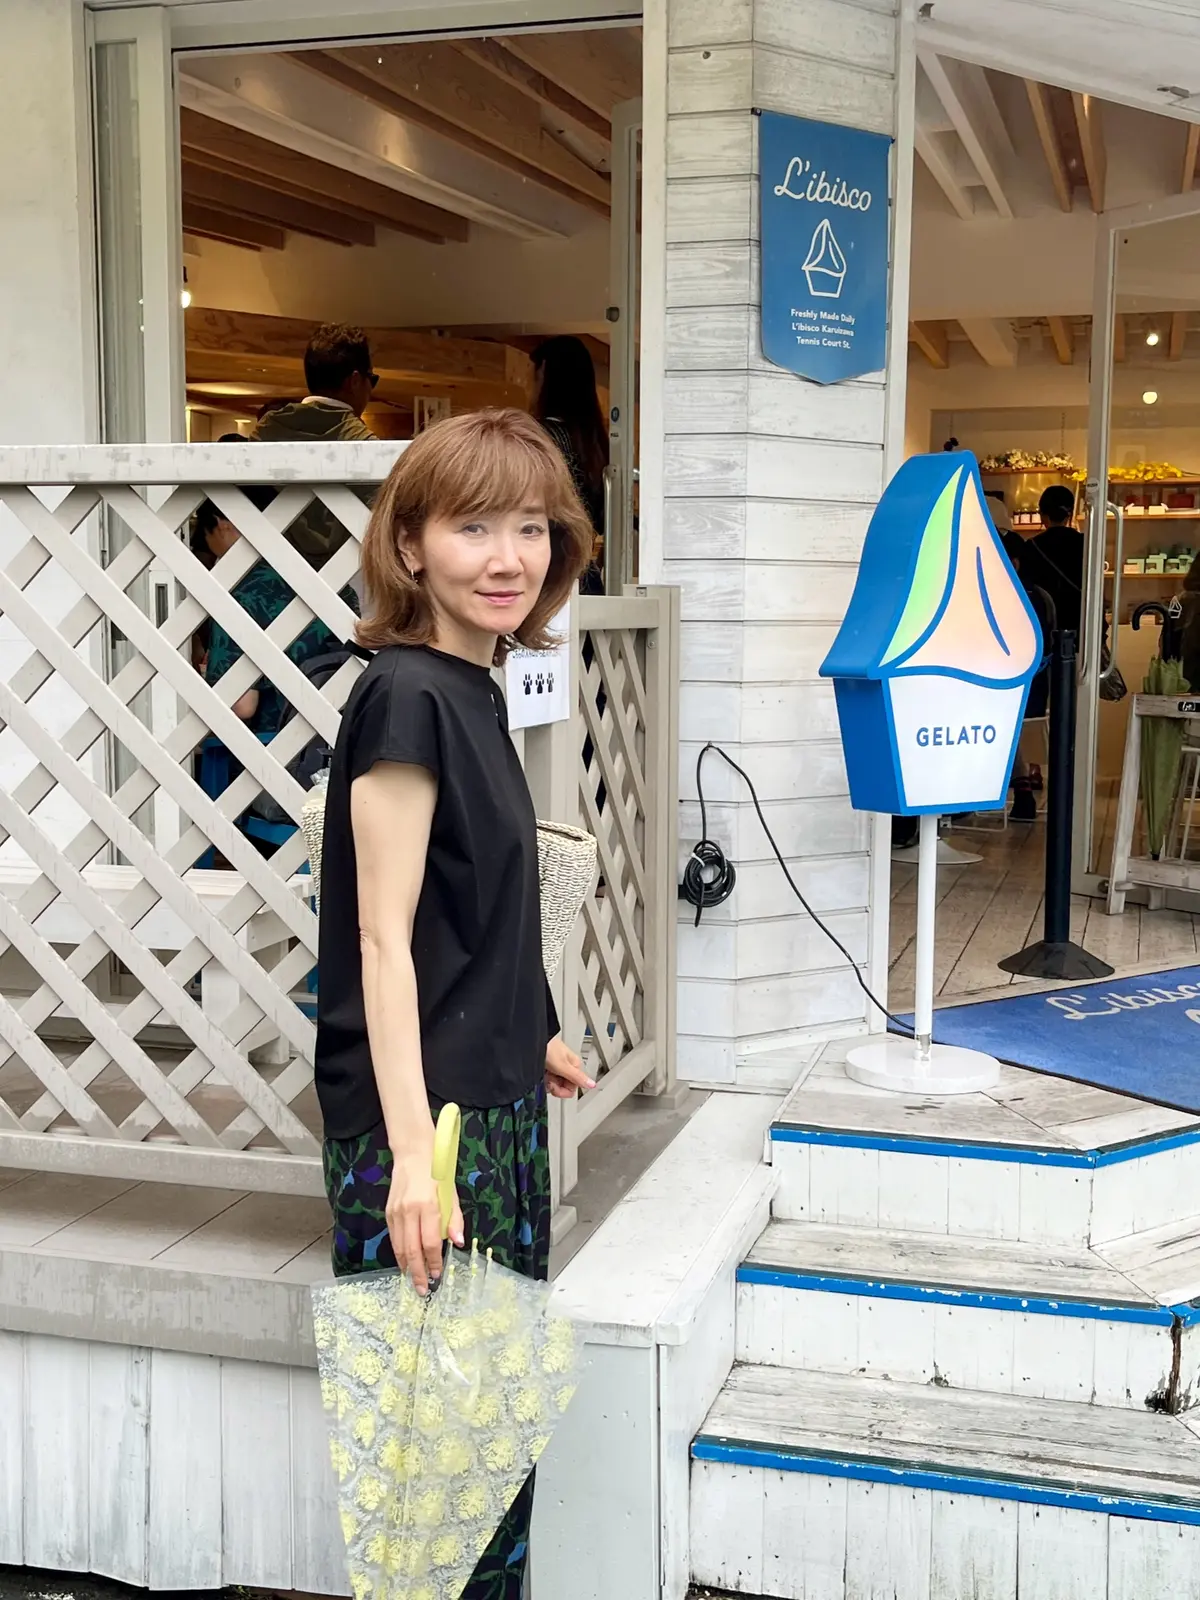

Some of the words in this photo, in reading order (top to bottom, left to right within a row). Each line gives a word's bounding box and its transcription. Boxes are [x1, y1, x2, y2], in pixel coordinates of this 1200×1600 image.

[774, 156, 872, 212] L'ibisco
[790, 308, 818, 321] Freshly
[819, 311, 839, 320] Made
[840, 313, 856, 325] Daily
[792, 322, 820, 332] L'ibisco
[821, 325, 854, 337] Karuizawa
[796, 336, 820, 345] Tennis
[822, 338, 842, 348] Court
[842, 340, 851, 349] St.
[916, 724, 997, 747] GELATO
[1045, 982, 1200, 1020] L'ibisc
